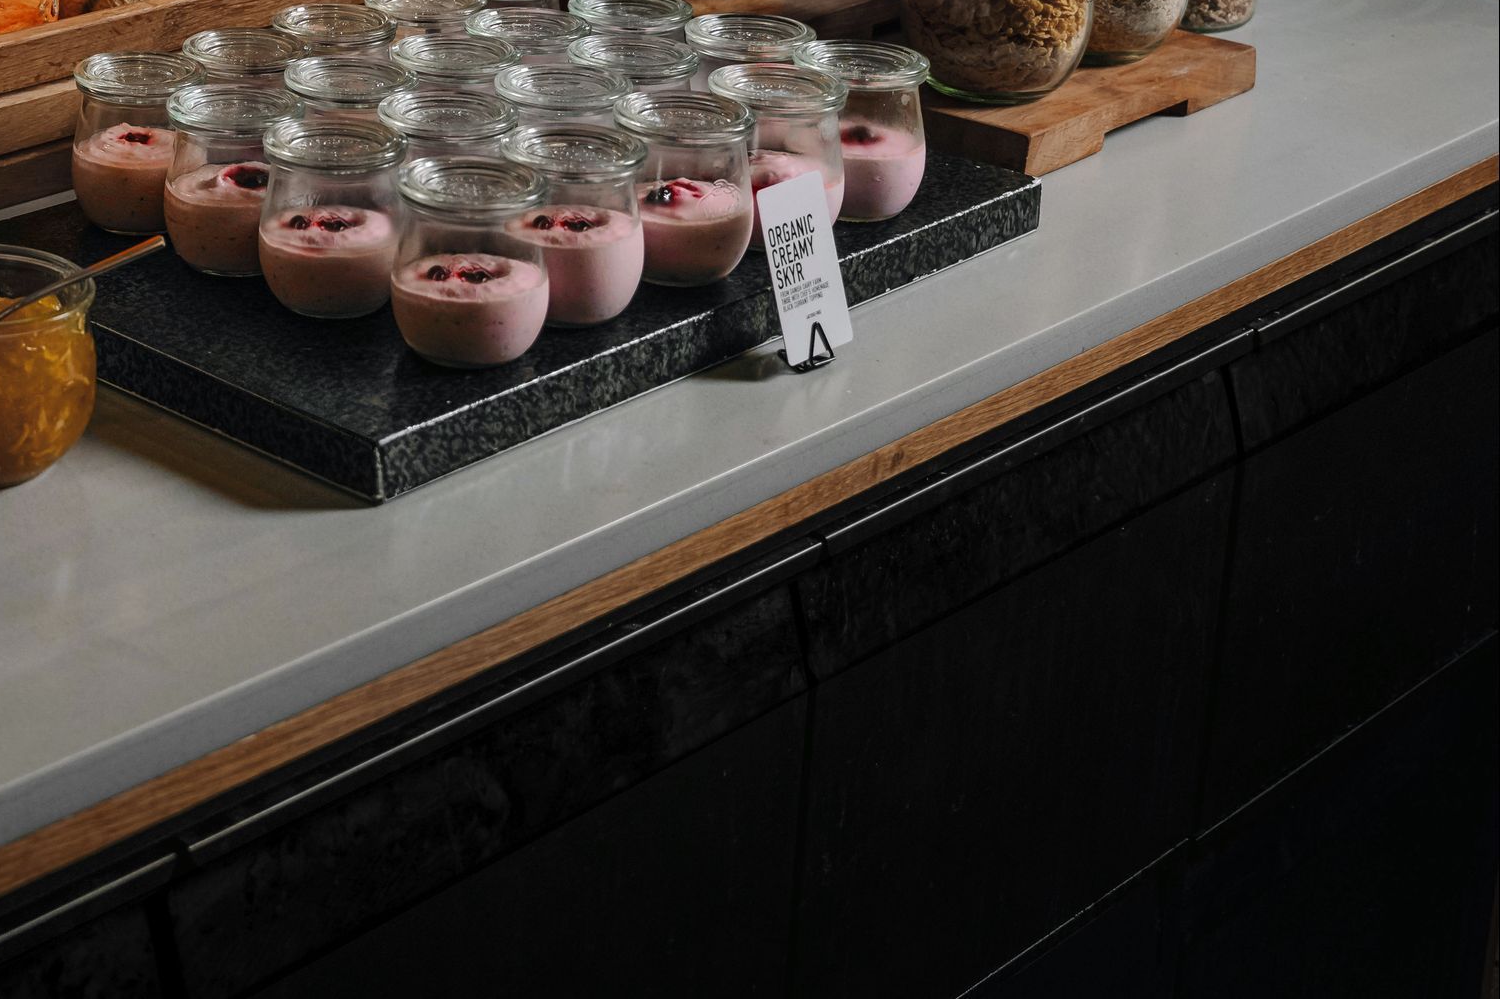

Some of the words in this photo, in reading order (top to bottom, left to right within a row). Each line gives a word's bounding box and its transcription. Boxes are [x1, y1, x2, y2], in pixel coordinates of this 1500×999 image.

[768, 213, 815, 248] ORGANIC
[772, 235, 814, 269] CREAMY
[775, 262, 805, 289] SKYR
